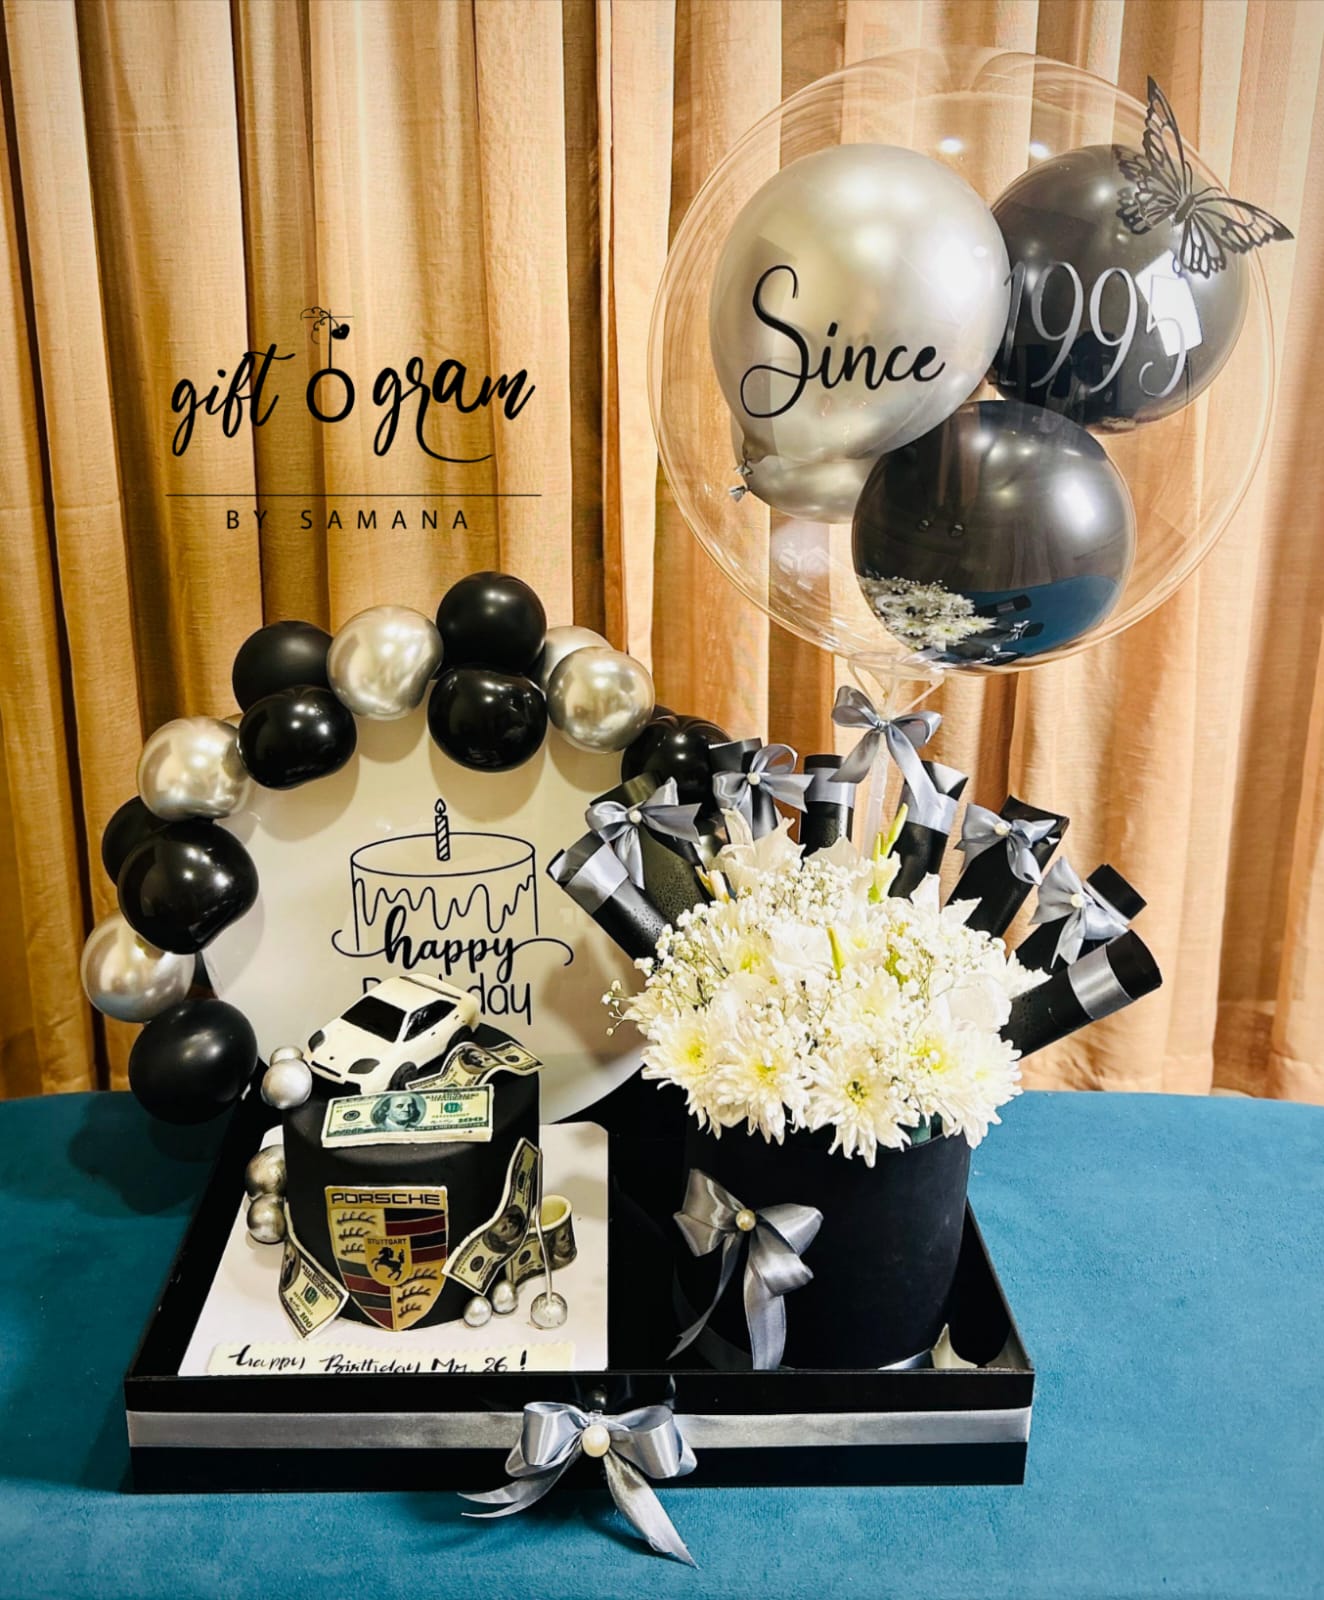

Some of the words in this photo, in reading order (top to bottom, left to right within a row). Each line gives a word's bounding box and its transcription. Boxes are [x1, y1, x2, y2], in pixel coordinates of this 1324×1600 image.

[739, 264, 946, 418] Since
[988, 261, 1187, 398] 1995
[385, 905, 514, 984] happy
[330, 1192, 441, 1206] PORSCHE
